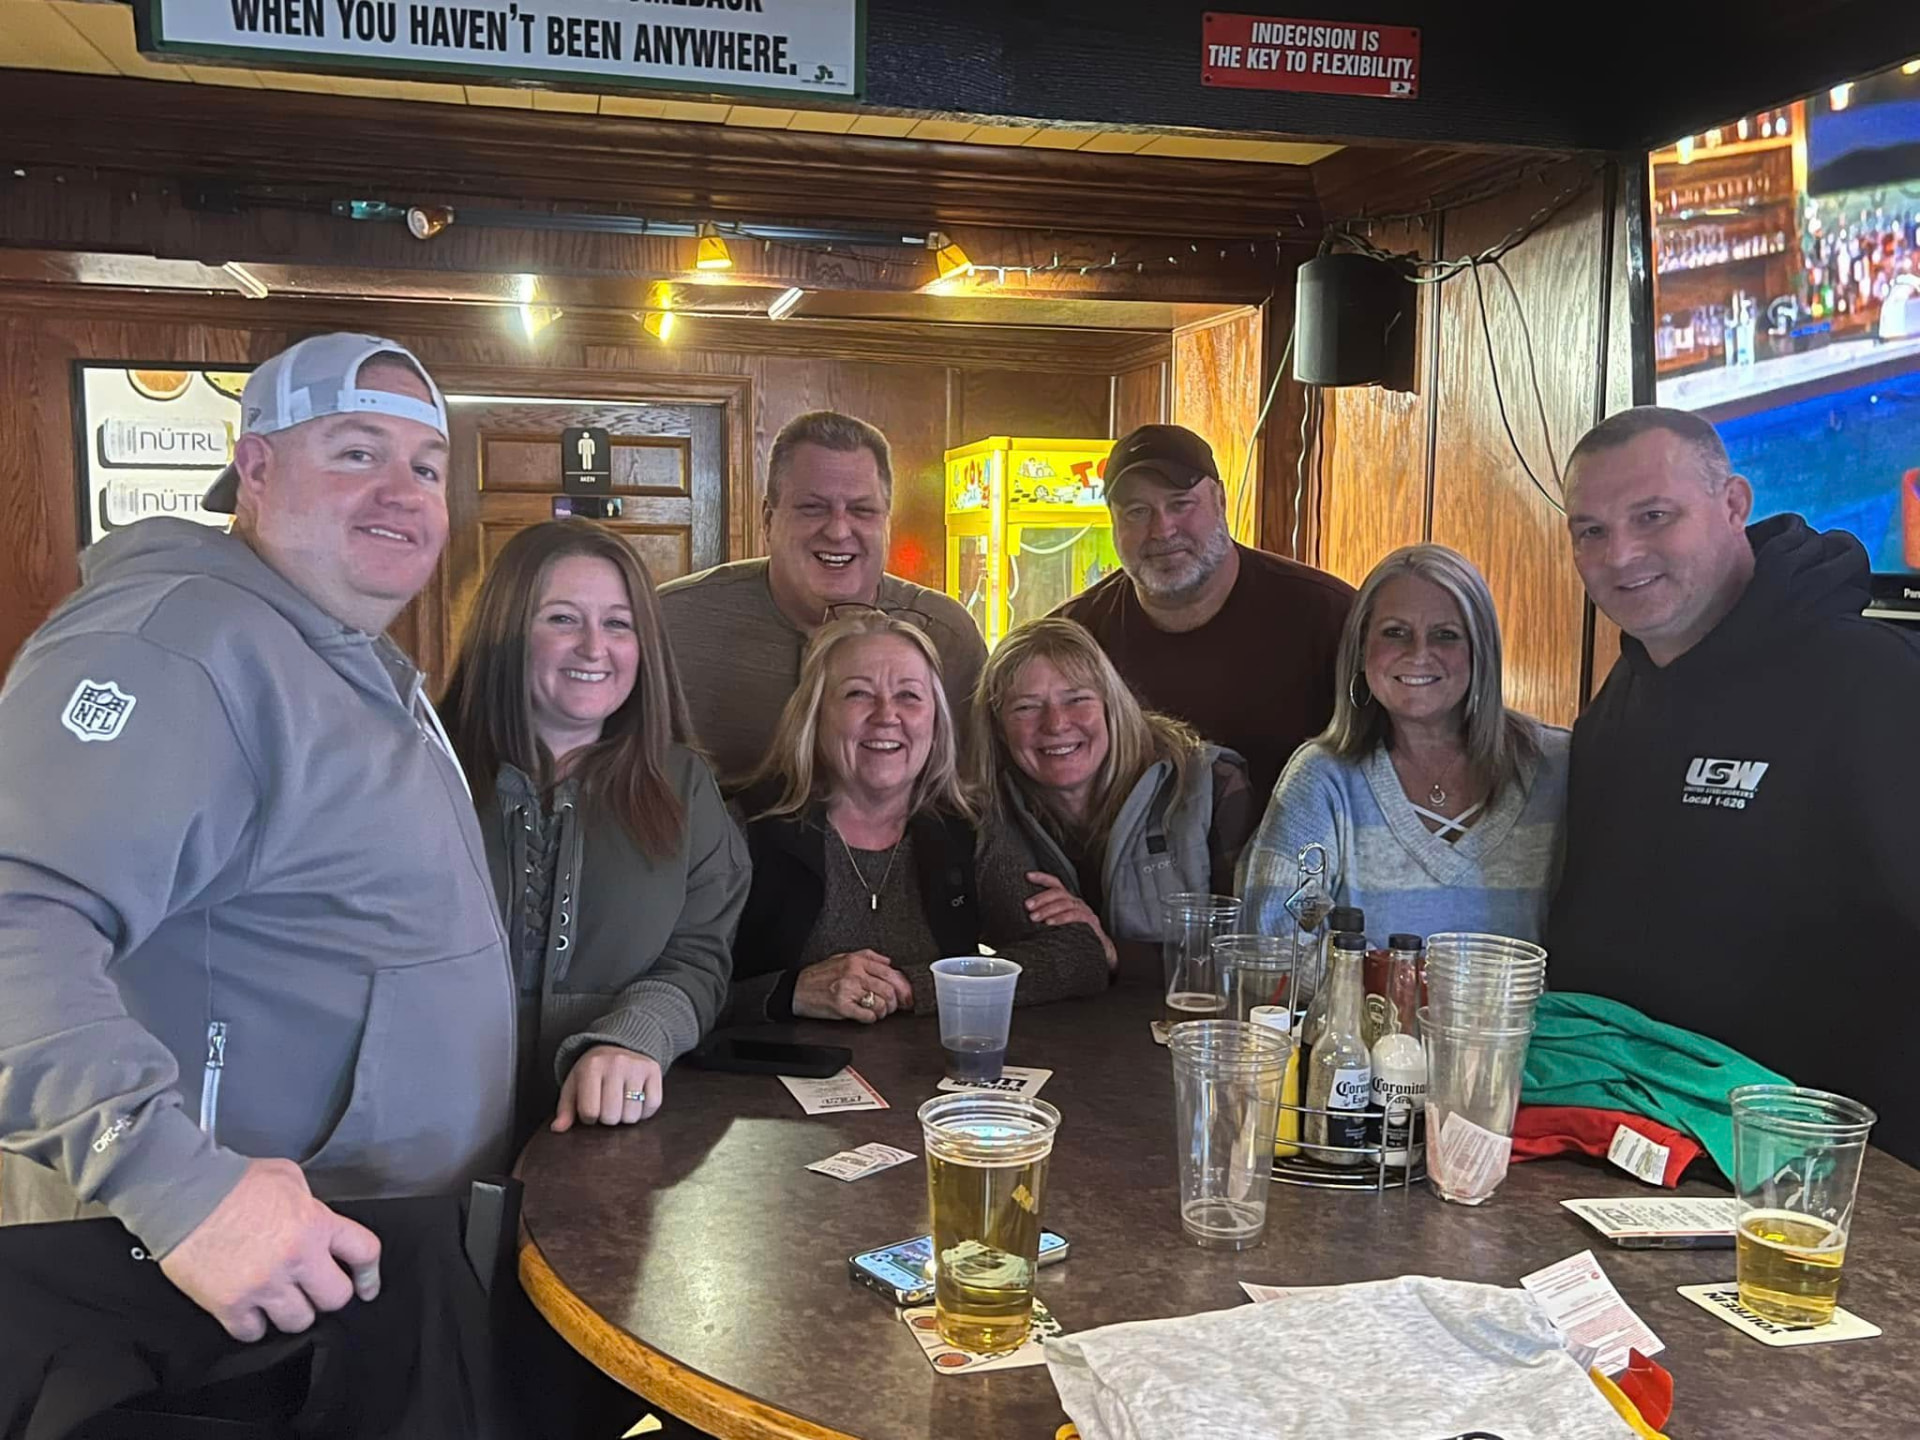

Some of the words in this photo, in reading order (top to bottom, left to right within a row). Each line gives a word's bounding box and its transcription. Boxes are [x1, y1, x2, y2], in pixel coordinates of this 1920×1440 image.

[230, 0, 325, 37] WHEN
[335, 0, 397, 43] YOU
[410, 3, 535, 54] HAVEN'T
[547, 15, 622, 61] BEEN
[633, 24, 798, 76] ANYWHERE.
[1251, 22, 1357, 50] INDECISION
[1362, 30, 1380, 51] IS
[1208, 45, 1242, 68] THE
[1246, 47, 1281, 70] KEY
[1285, 50, 1307, 72] TO
[1312, 52, 1416, 79] FLEXIBILITY.
[74, 702, 112, 730] NFL
[1685, 757, 1769, 791] USW
[1682, 793, 1713, 806] Local
